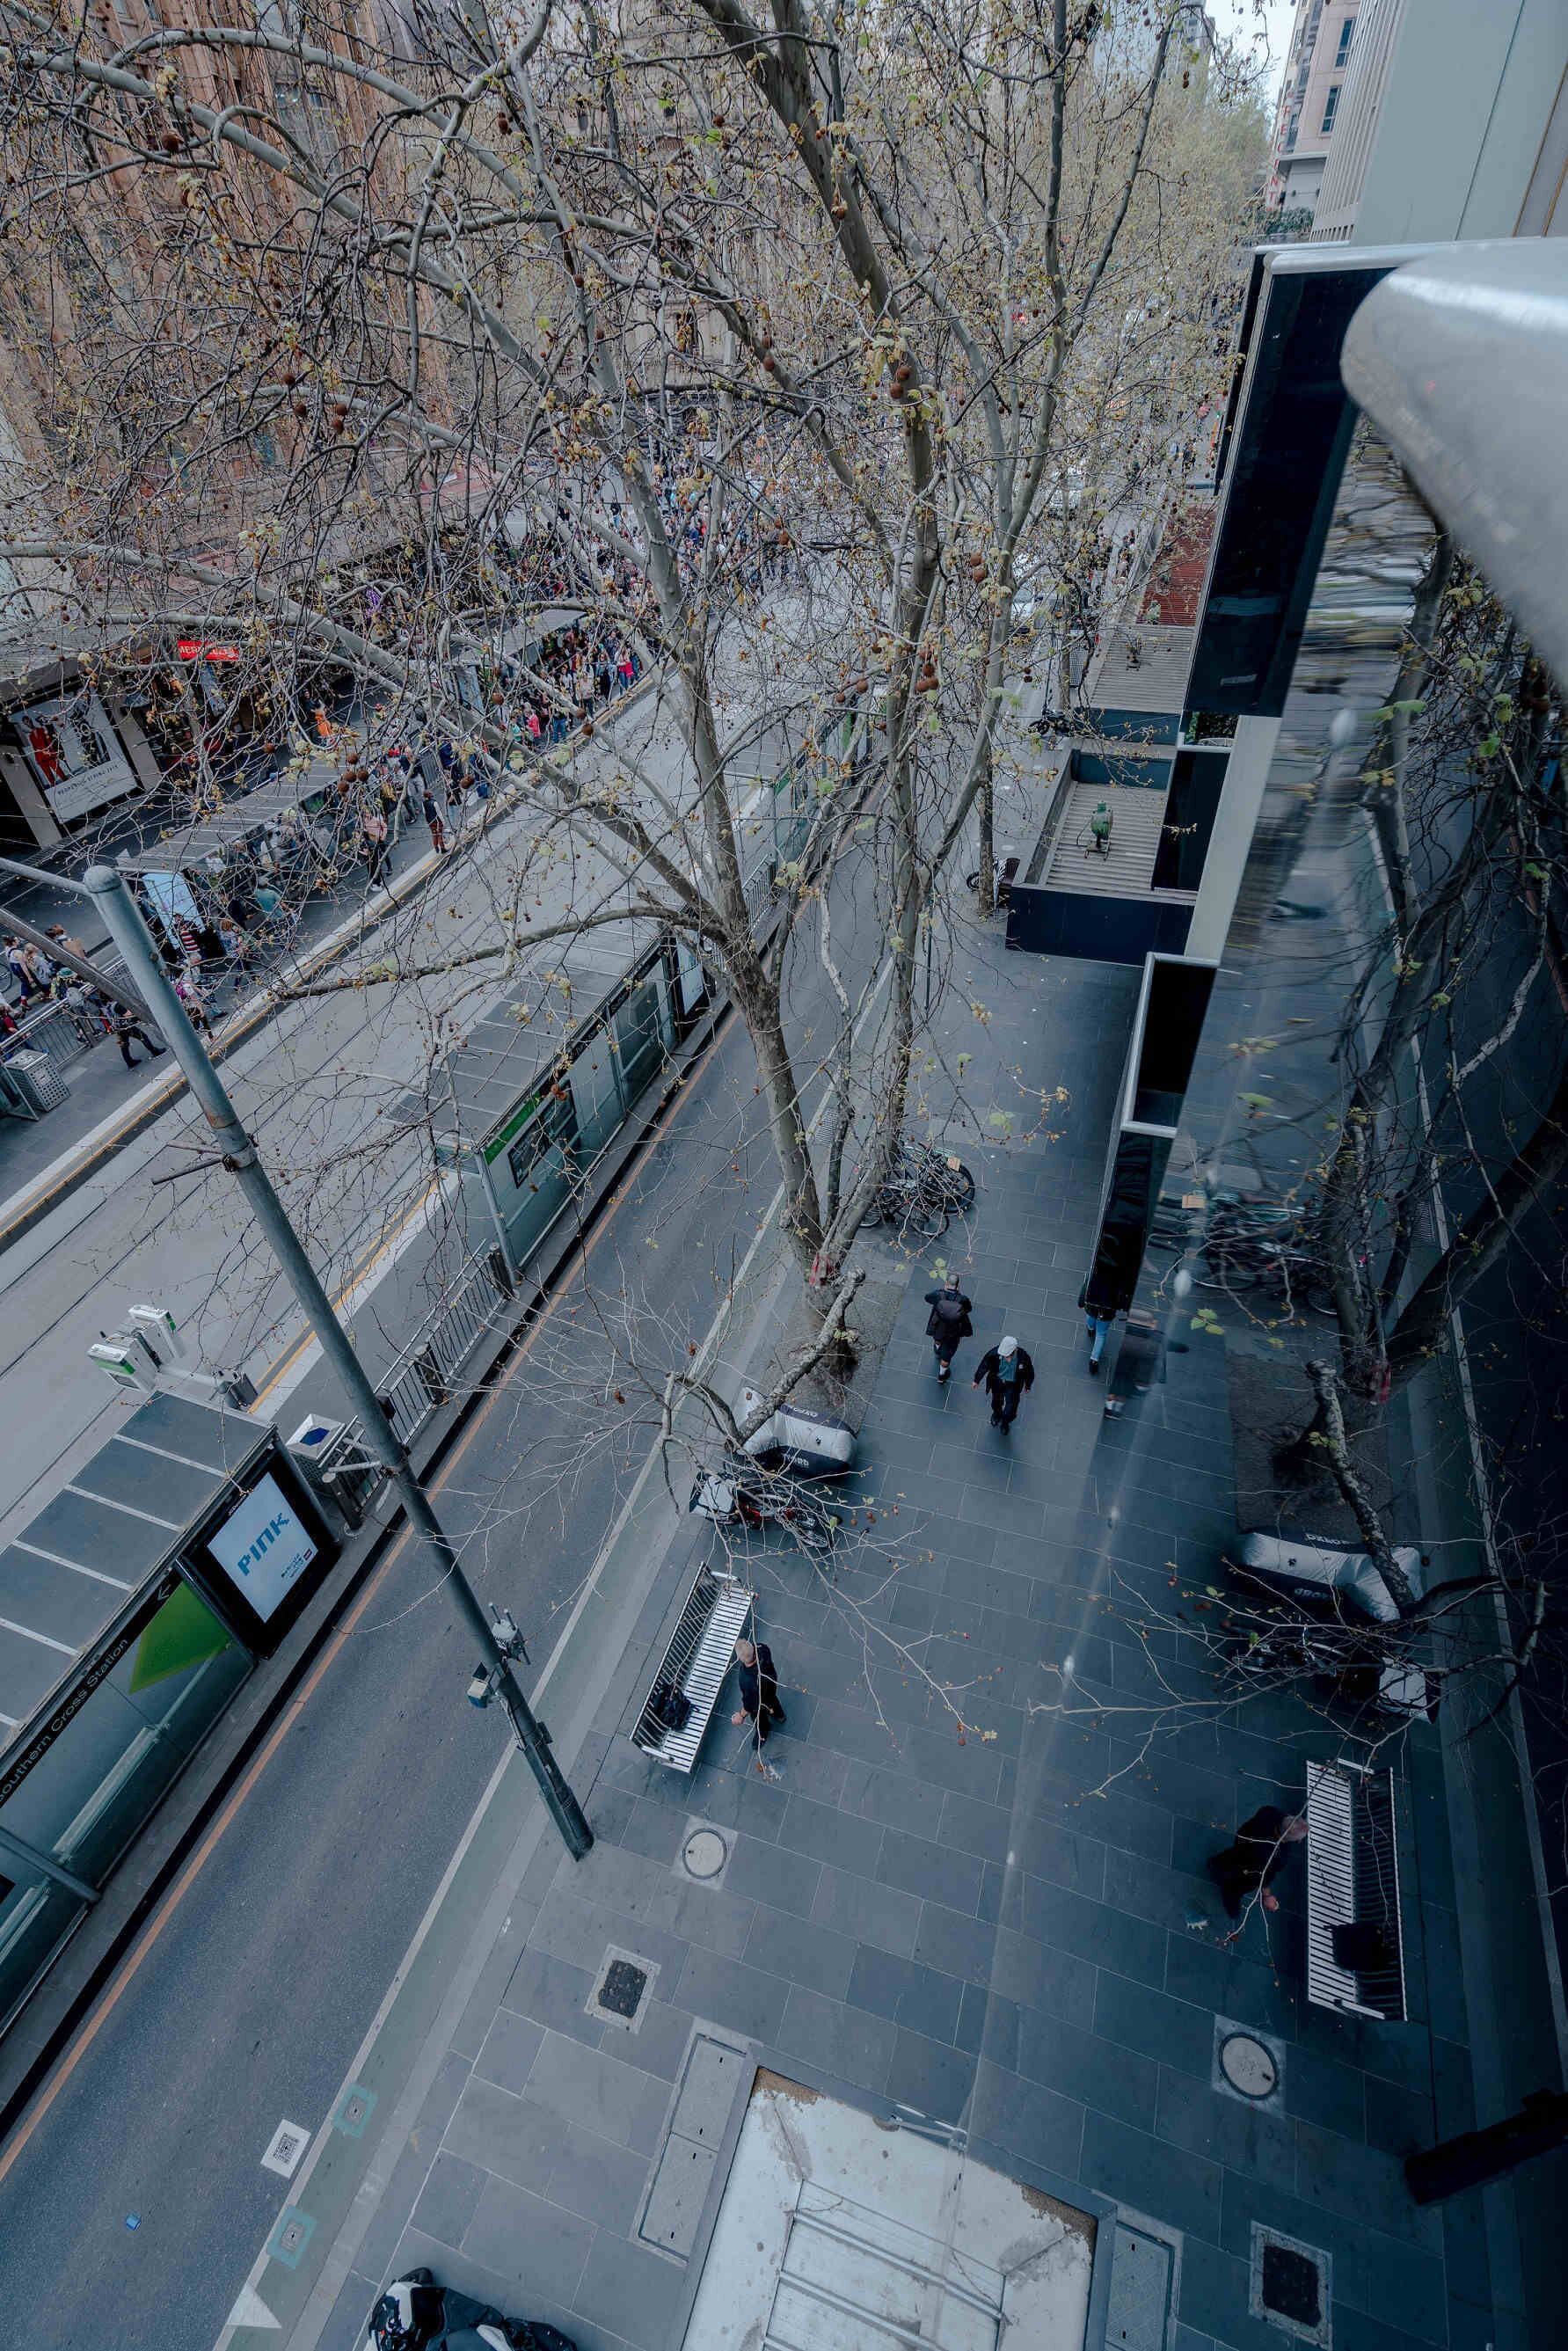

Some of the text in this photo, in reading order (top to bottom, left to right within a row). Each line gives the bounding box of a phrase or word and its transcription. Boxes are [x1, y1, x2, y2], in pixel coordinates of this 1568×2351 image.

[237, 1512, 289, 1576] PINK
[51, 1689, 88, 1732] Cross
[87, 1639, 128, 1688] Station
